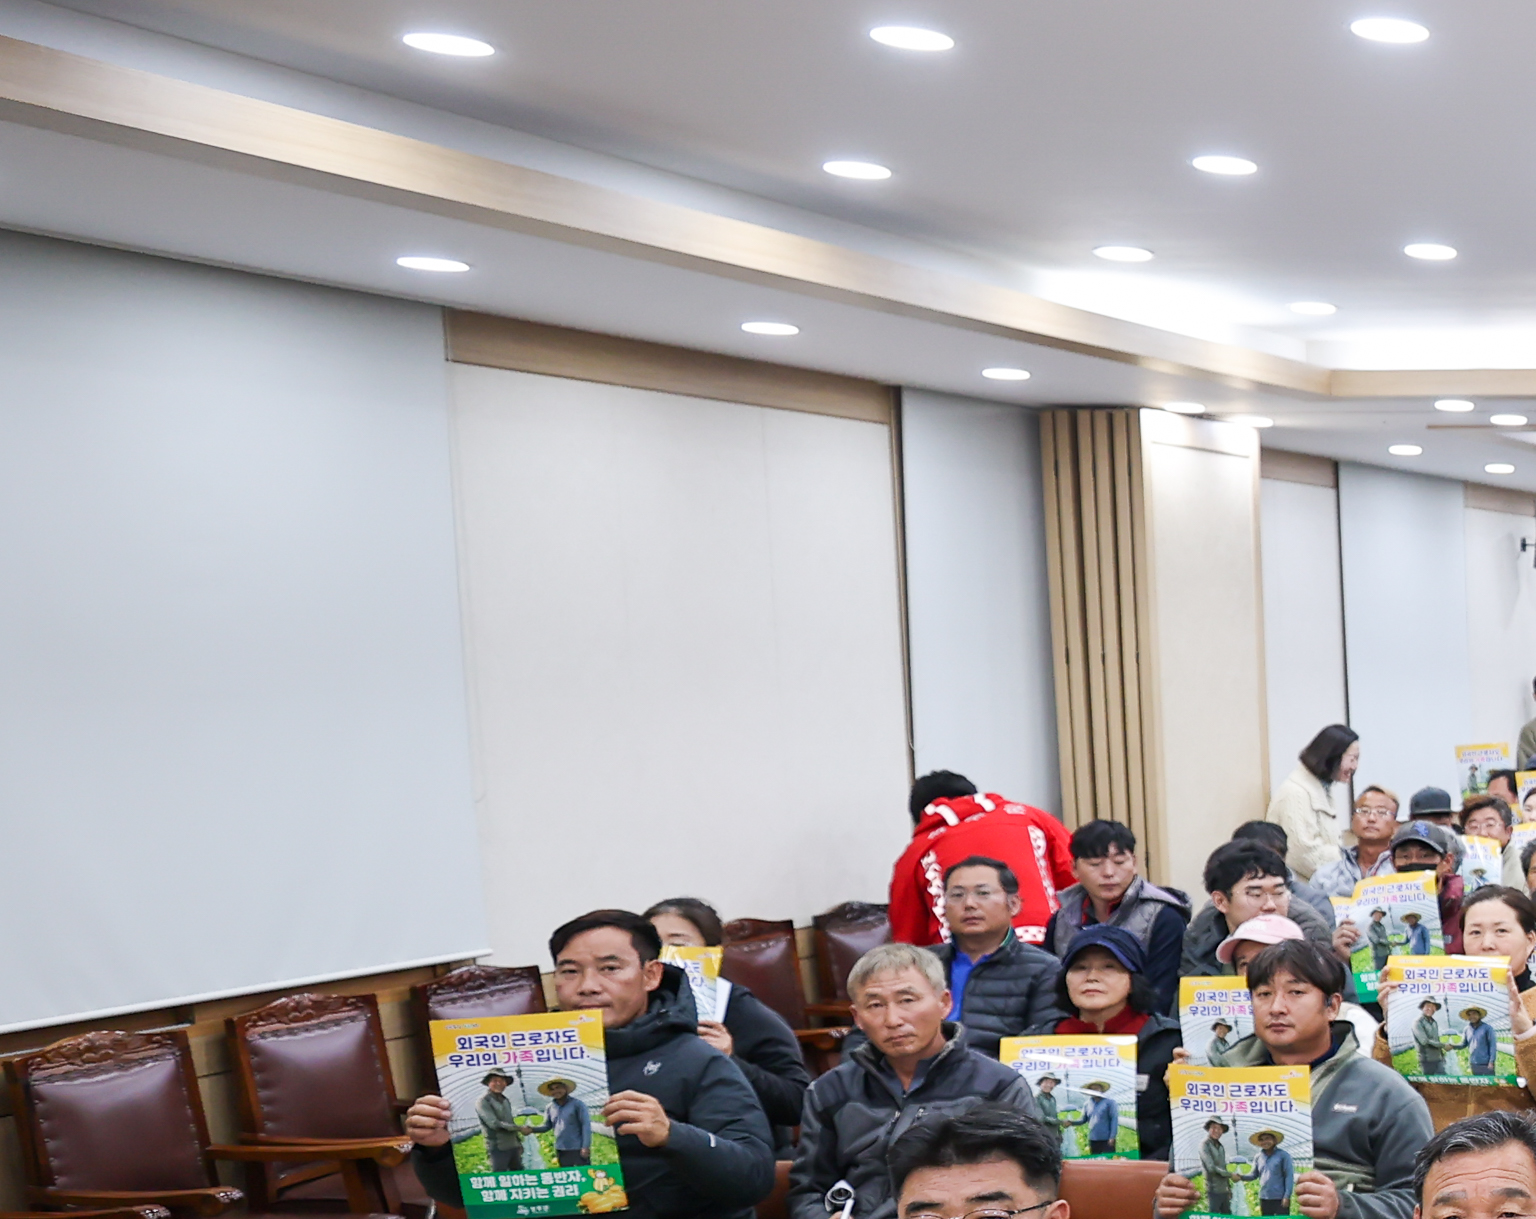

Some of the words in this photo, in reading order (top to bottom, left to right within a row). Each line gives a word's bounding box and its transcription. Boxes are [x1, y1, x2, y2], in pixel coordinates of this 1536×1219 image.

[1404, 969, 1439, 980] 외국인
[1443, 968, 1489, 980] 근로자도
[1397, 982, 1431, 994] 우리의
[1435, 982, 1497, 993] 가족입니다.
[1195, 991, 1228, 1003] 외국인
[1188, 1005, 1222, 1017] 우리의
[456, 1034, 507, 1051] 외국인
[511, 1029, 577, 1048] 근로자도
[447, 1052, 498, 1069] 우리의
[502, 1046, 591, 1065] 가족입니다.
[1186, 1083, 1226, 1097] 외국인
[1231, 1082, 1288, 1097] 근로자도
[1180, 1099, 1217, 1113] 우리의
[1221, 1098, 1298, 1114] 가족입니다.
[468, 1176, 497, 1190] 함께
[498, 1173, 539, 1187] 일하는
[540, 1170, 586, 1184] 동반자,
[480, 1189, 508, 1203] 함께
[508, 1187, 550, 1200] 지키는
[552, 1184, 579, 1197] 권리
